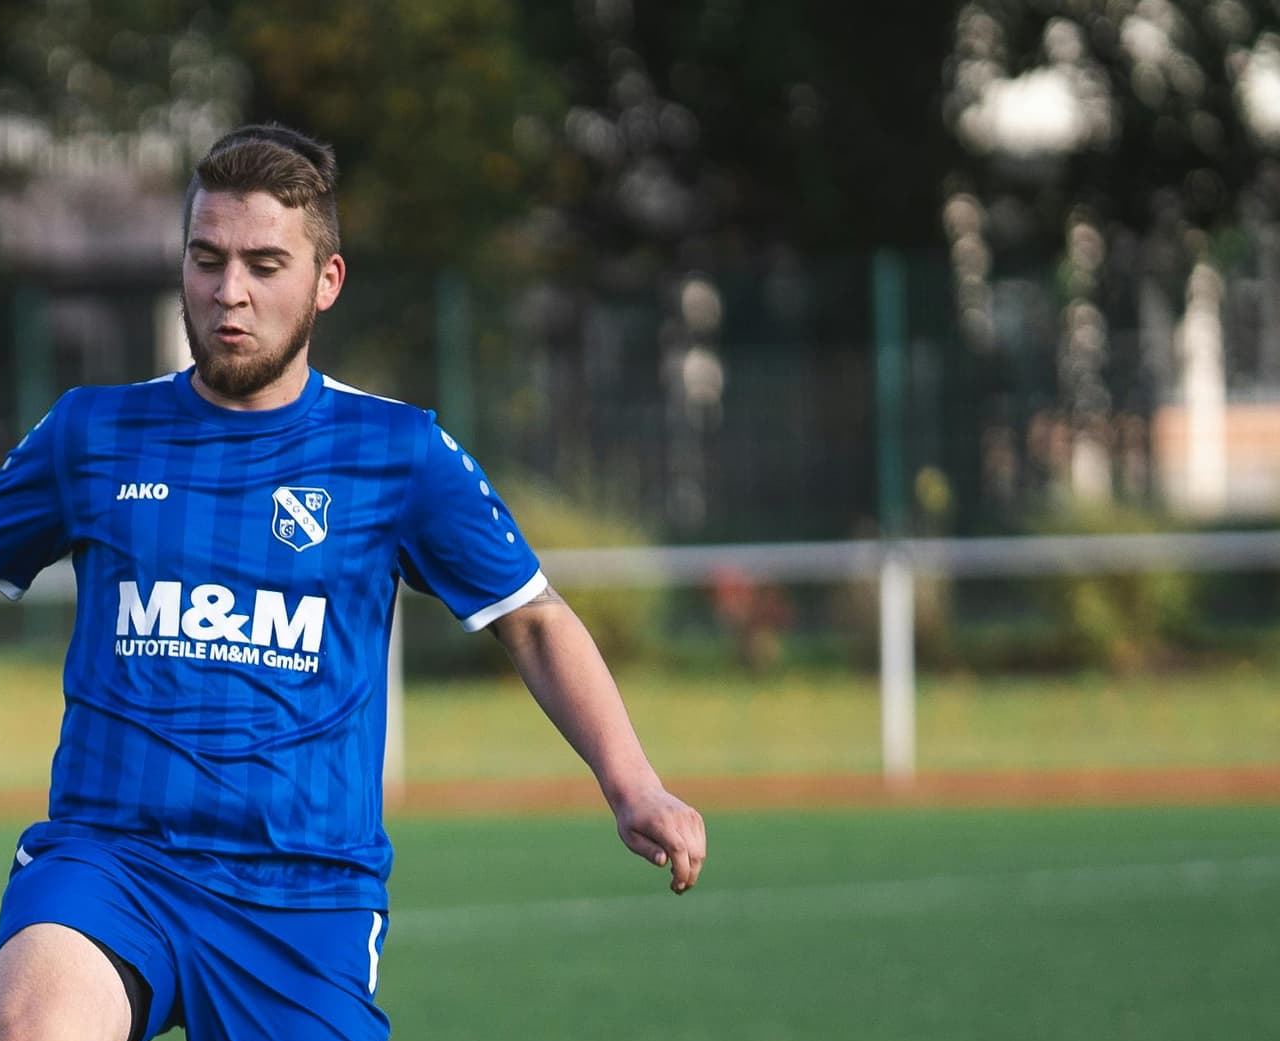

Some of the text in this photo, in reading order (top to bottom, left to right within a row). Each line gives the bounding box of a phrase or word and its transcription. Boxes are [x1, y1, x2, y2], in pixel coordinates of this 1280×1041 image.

[116, 482, 169, 500] JAKO
[116, 581, 327, 653] M&M
[115, 639, 320, 674] AUTOTEILE M&M GmbH
